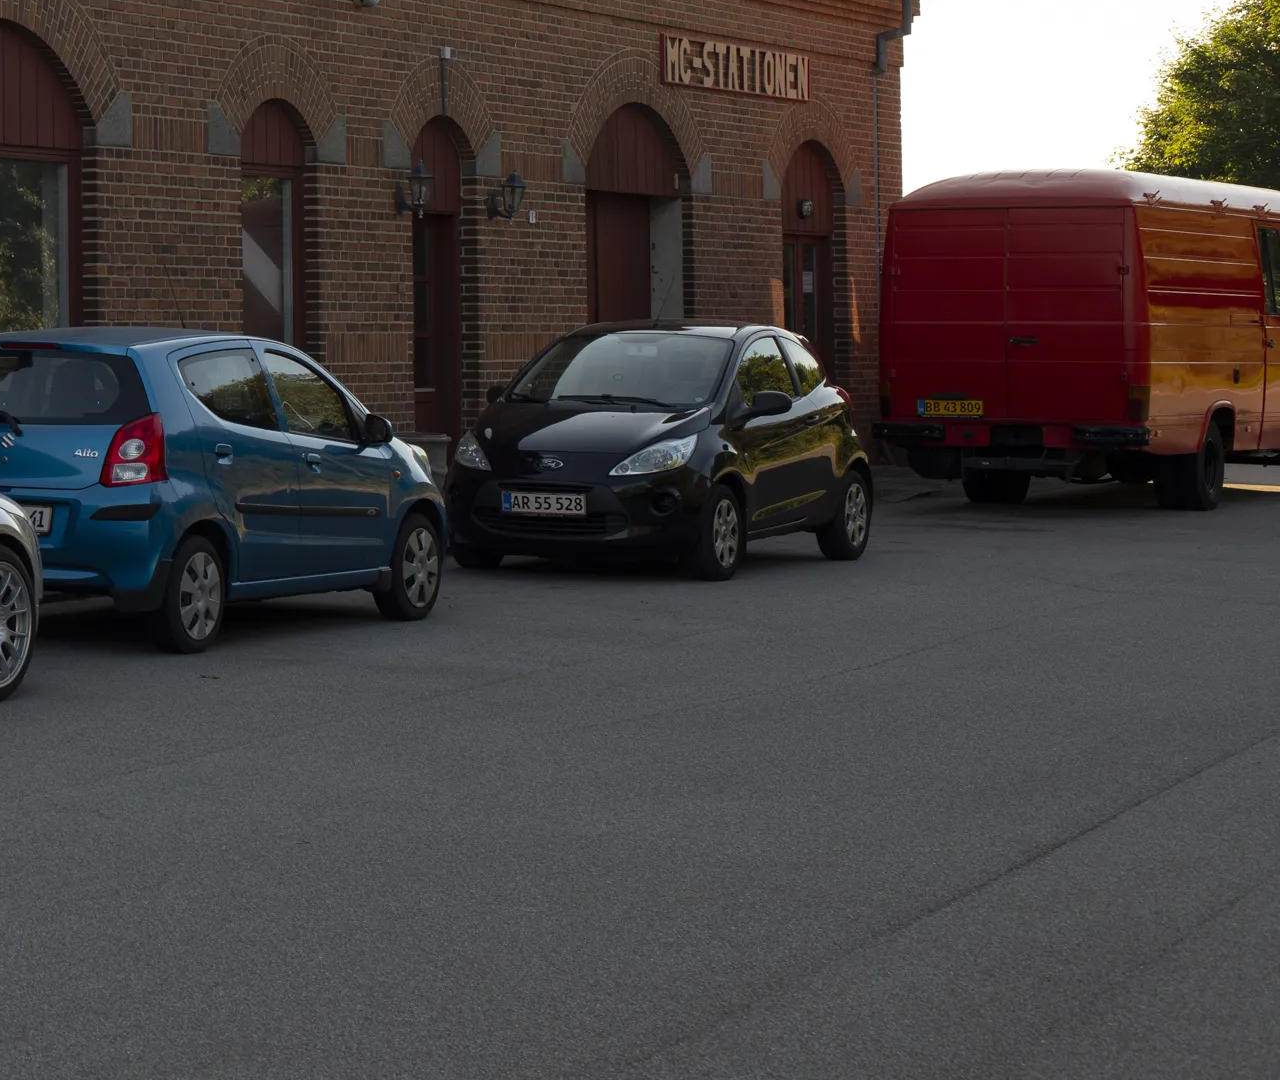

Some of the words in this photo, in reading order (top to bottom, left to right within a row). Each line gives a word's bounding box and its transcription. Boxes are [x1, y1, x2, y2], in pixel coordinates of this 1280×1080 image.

[666, 35, 810, 101] MC-STATIONEN
[925, 402, 940, 413] BB
[943, 402, 957, 413] 43
[959, 402, 981, 413] 809
[74, 448, 99, 458] Alto
[512, 495, 530, 509] AR
[534, 496, 552, 510] 55
[555, 497, 583, 512] 528
